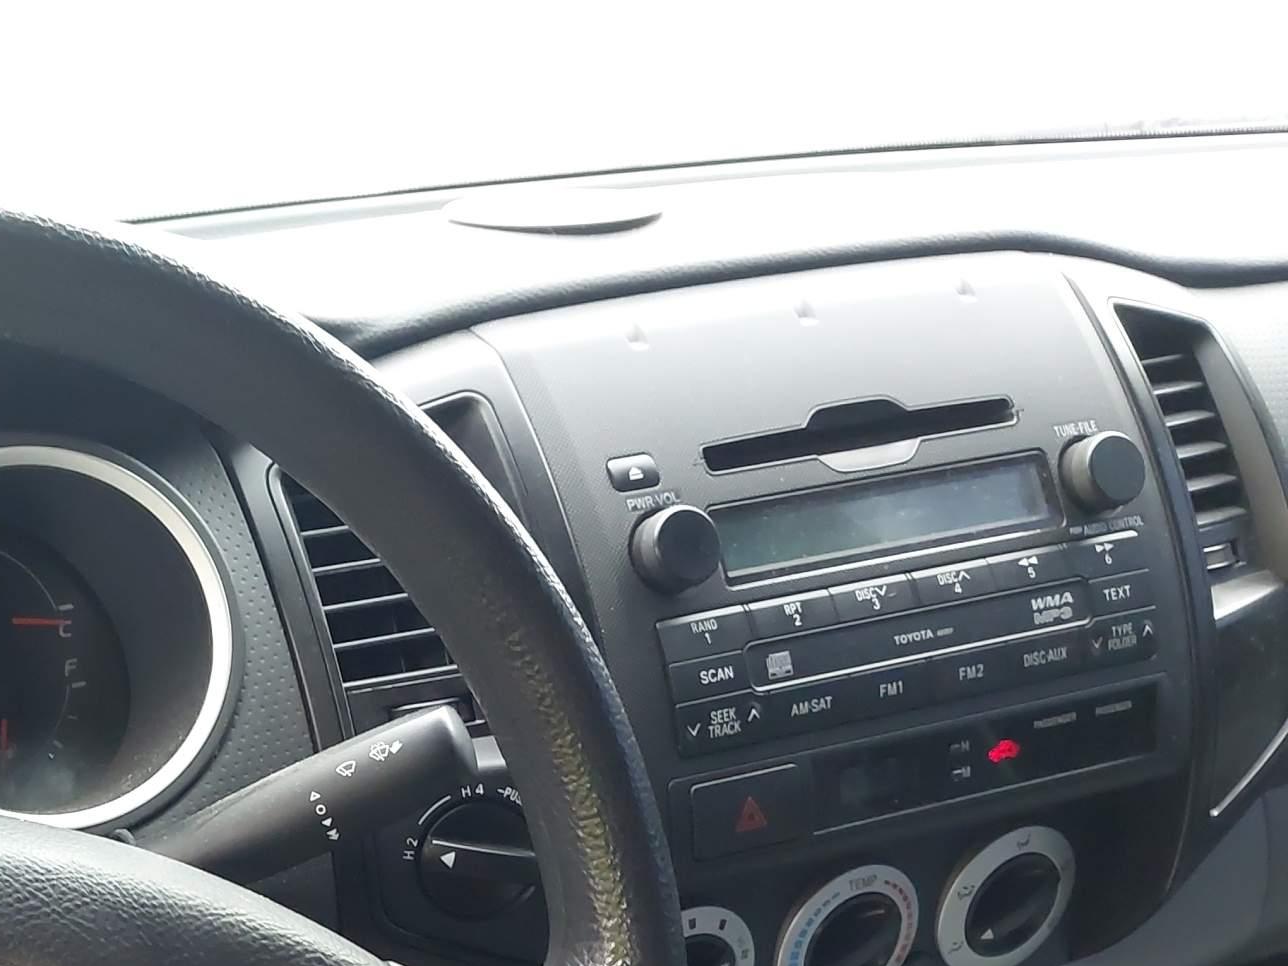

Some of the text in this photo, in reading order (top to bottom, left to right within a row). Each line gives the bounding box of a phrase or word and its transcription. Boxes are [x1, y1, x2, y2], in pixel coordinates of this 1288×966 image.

[1105, 553, 1112, 565] 6
[1028, 566, 1036, 578] 5
[954, 584, 963, 594] 4
[1103, 585, 1131, 601] TEXT
[784, 602, 803, 616] RPT
[872, 598, 880, 610] 3
[1031, 592, 1073, 611] WMA
[793, 614, 802, 626] 2
[1034, 606, 1073, 625] MP3
[690, 619, 718, 633] RAND
[1112, 622, 1133, 636] TYPE
[704, 633, 712, 644] 1
[894, 629, 934, 645] TOYOTA
[65, 658, 78, 677] F
[699, 666, 735, 684] SCAN
[959, 664, 984, 680] FM2
[880, 681, 903, 697] FM1
[710, 708, 737, 724] SEEK
[708, 721, 741, 738] TRACK
